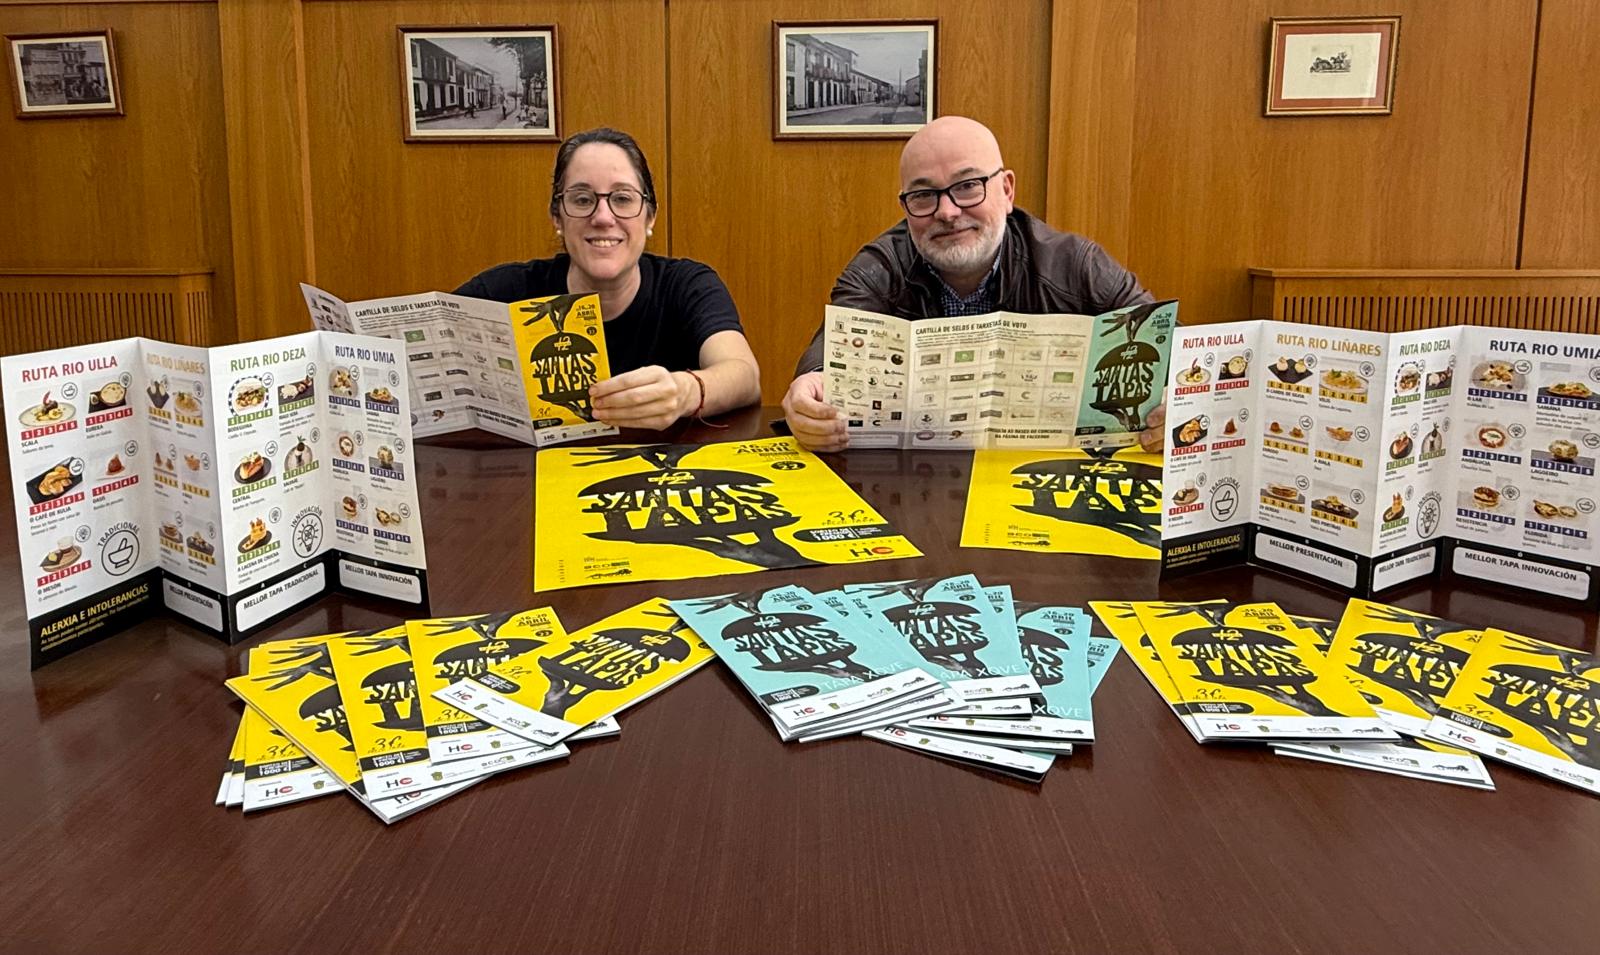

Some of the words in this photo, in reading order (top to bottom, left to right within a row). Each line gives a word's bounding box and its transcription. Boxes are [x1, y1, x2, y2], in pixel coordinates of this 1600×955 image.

[355, 307, 381, 317] CARTILLA
[382, 306, 390, 314] DE
[391, 304, 409, 312] SELOS
[916, 326, 942, 335] CARTILLA
[952, 324, 970, 332] SELOS
[976, 320, 1002, 330] TARXETAS
[1012, 321, 1028, 329] VOTO
[1182, 336, 1205, 349] RUTA
[1206, 335, 1222, 346] RIO
[1224, 333, 1245, 345] ULLA
[1277, 334, 1305, 346] RUTA
[1308, 338, 1328, 349] RIO
[1332, 338, 1382, 357] LIÑARES
[1400, 342, 1419, 356] RUTA
[1420, 341, 1432, 352] RIO
[1434, 340, 1450, 351] DEZA
[1490, 340, 1527, 354] RUTA
[1532, 343, 1558, 356] RIO
[1563, 346, 1600, 360] UMIA
[230, 356, 260, 372] RUTA
[262, 352, 280, 366] RIO
[282, 347, 306, 362] DEZA
[335, 345, 355, 360] RUTA
[356, 348, 371, 361] RIO
[372, 350, 396, 365] UMIA
[534, 353, 597, 376] SANTAS
[22, 364, 58, 382] RUTA
[62, 361, 84, 376] RIO
[88, 356, 118, 372] ULLA
[1095, 361, 1154, 384] SANTAS
[1092, 381, 1153, 403] TAPAS
[1012, 473, 1161, 492] SANTA
[589, 484, 780, 509] SANTAS
[582, 503, 793, 533] TAPAS
[97, 521, 140, 547] TRADICIONAL
[1166, 545, 1192, 557] ALERXIA
[1192, 543, 1196, 552] E
[1269, 539, 1295, 552] MELLOR
[1296, 545, 1343, 568] PRESENTACIÓN
[1464, 552, 1498, 566] MELLOR
[1499, 558, 1520, 570] TAPA
[1521, 562, 1577, 582] INNOVACIÓN
[244, 594, 268, 609] MELLOR
[269, 586, 284, 597] TAPA
[284, 569, 319, 590] TRADICIONAL
[40, 614, 78, 637] ALERXIA
[80, 610, 86, 620] E
[87, 583, 149, 617] INTOLERANCIAS
[735, 624, 840, 650] SANTAS
[909, 631, 990, 652] APAS
[1178, 643, 1302, 664] SANTAS
[1350, 639, 1463, 673] SANTA
[823, 674, 865, 691] TAPA
[862, 661, 905, 680] XOVE
[940, 668, 972, 680] APA
[976, 664, 1022, 677] XOVE
[1481, 667, 1600, 707] SANTA
[1034, 704, 1083, 718] XOVE
[1215, 722, 1241, 731] HC
[265, 786, 294, 797] HC
[386, 777, 413, 788] HC
